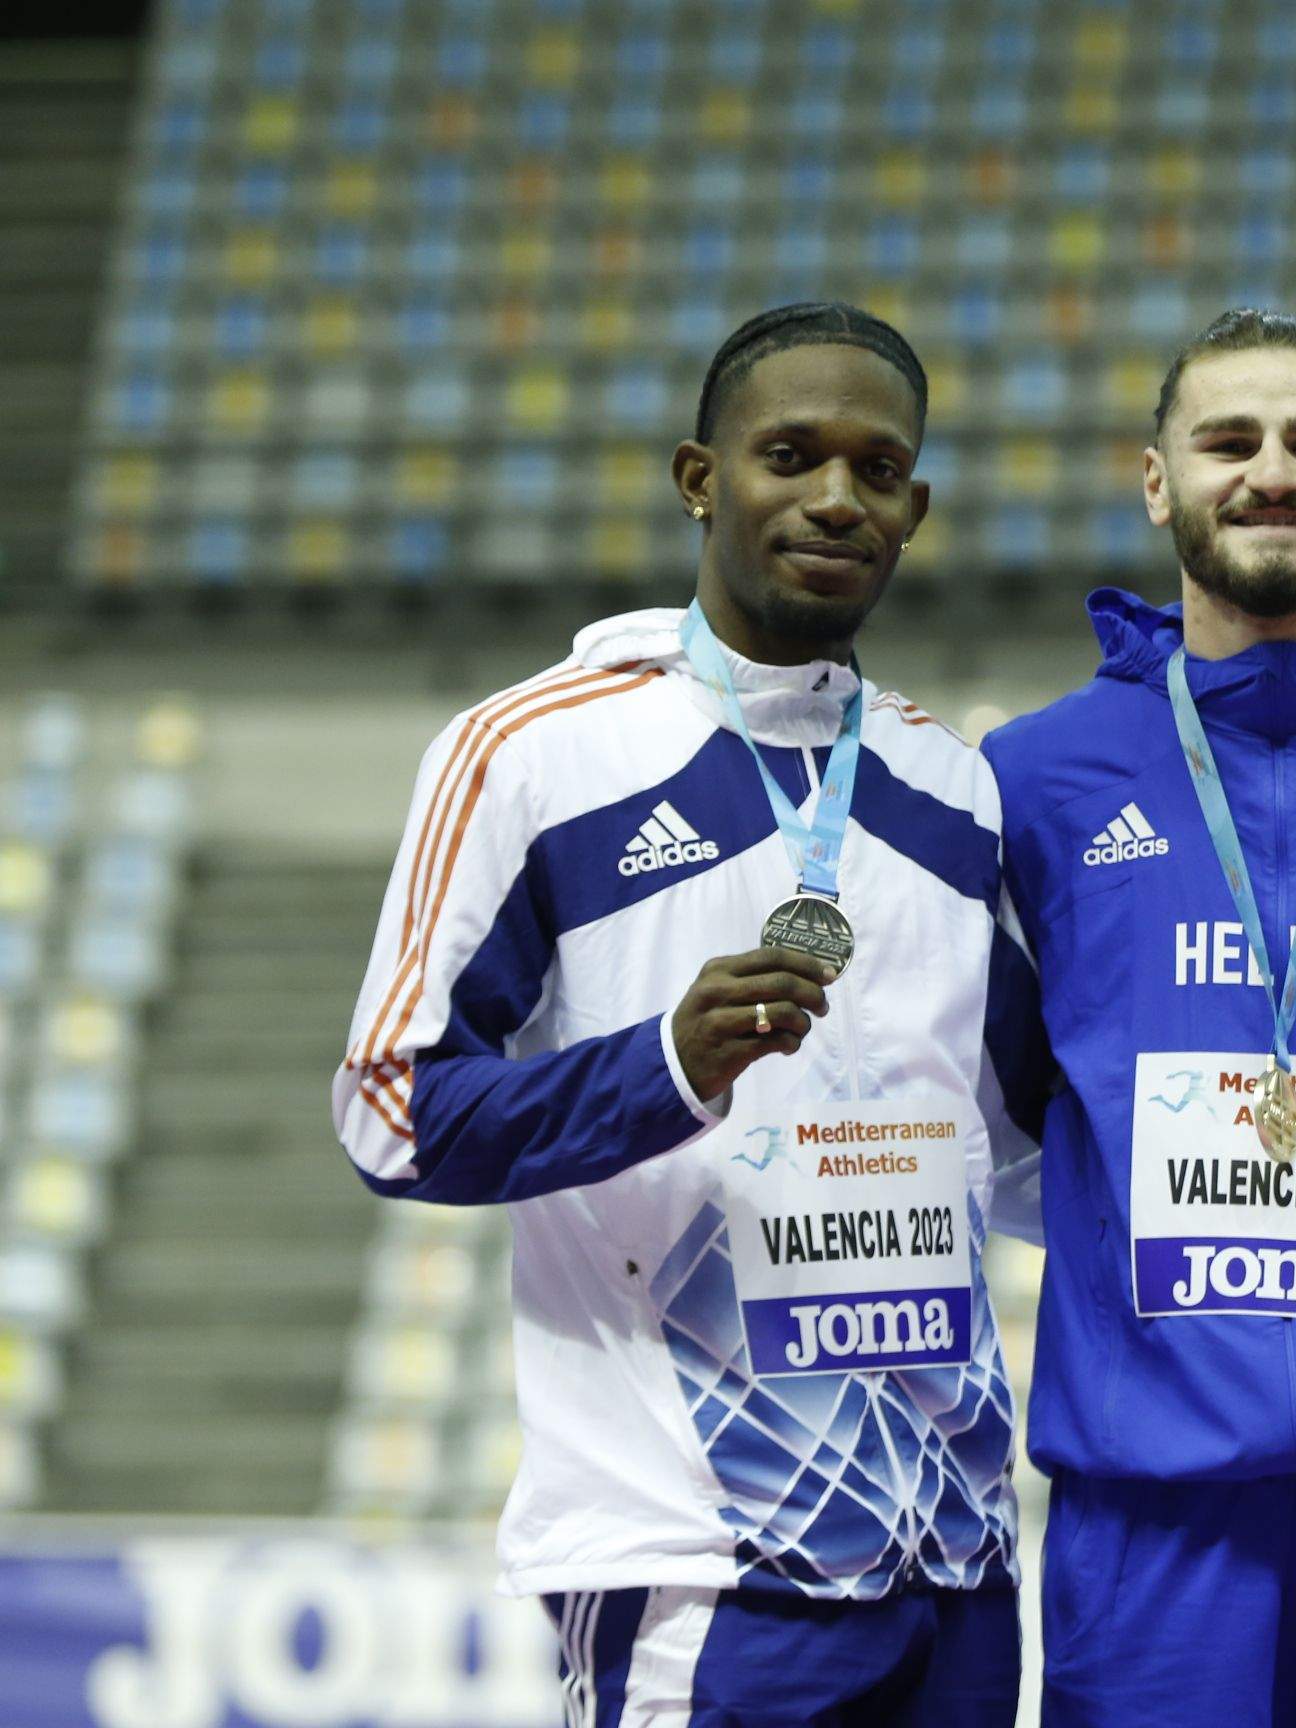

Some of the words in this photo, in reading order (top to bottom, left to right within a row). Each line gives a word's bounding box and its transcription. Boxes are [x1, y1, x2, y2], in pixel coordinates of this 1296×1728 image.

[617, 837, 720, 878] adidas
[1083, 835, 1169, 867] adidas
[797, 1118, 956, 1147] Mediterranean
[817, 1153, 918, 1178] Athletics
[761, 1208, 903, 1265] VALENCIA
[907, 1206, 954, 1257] 2023
